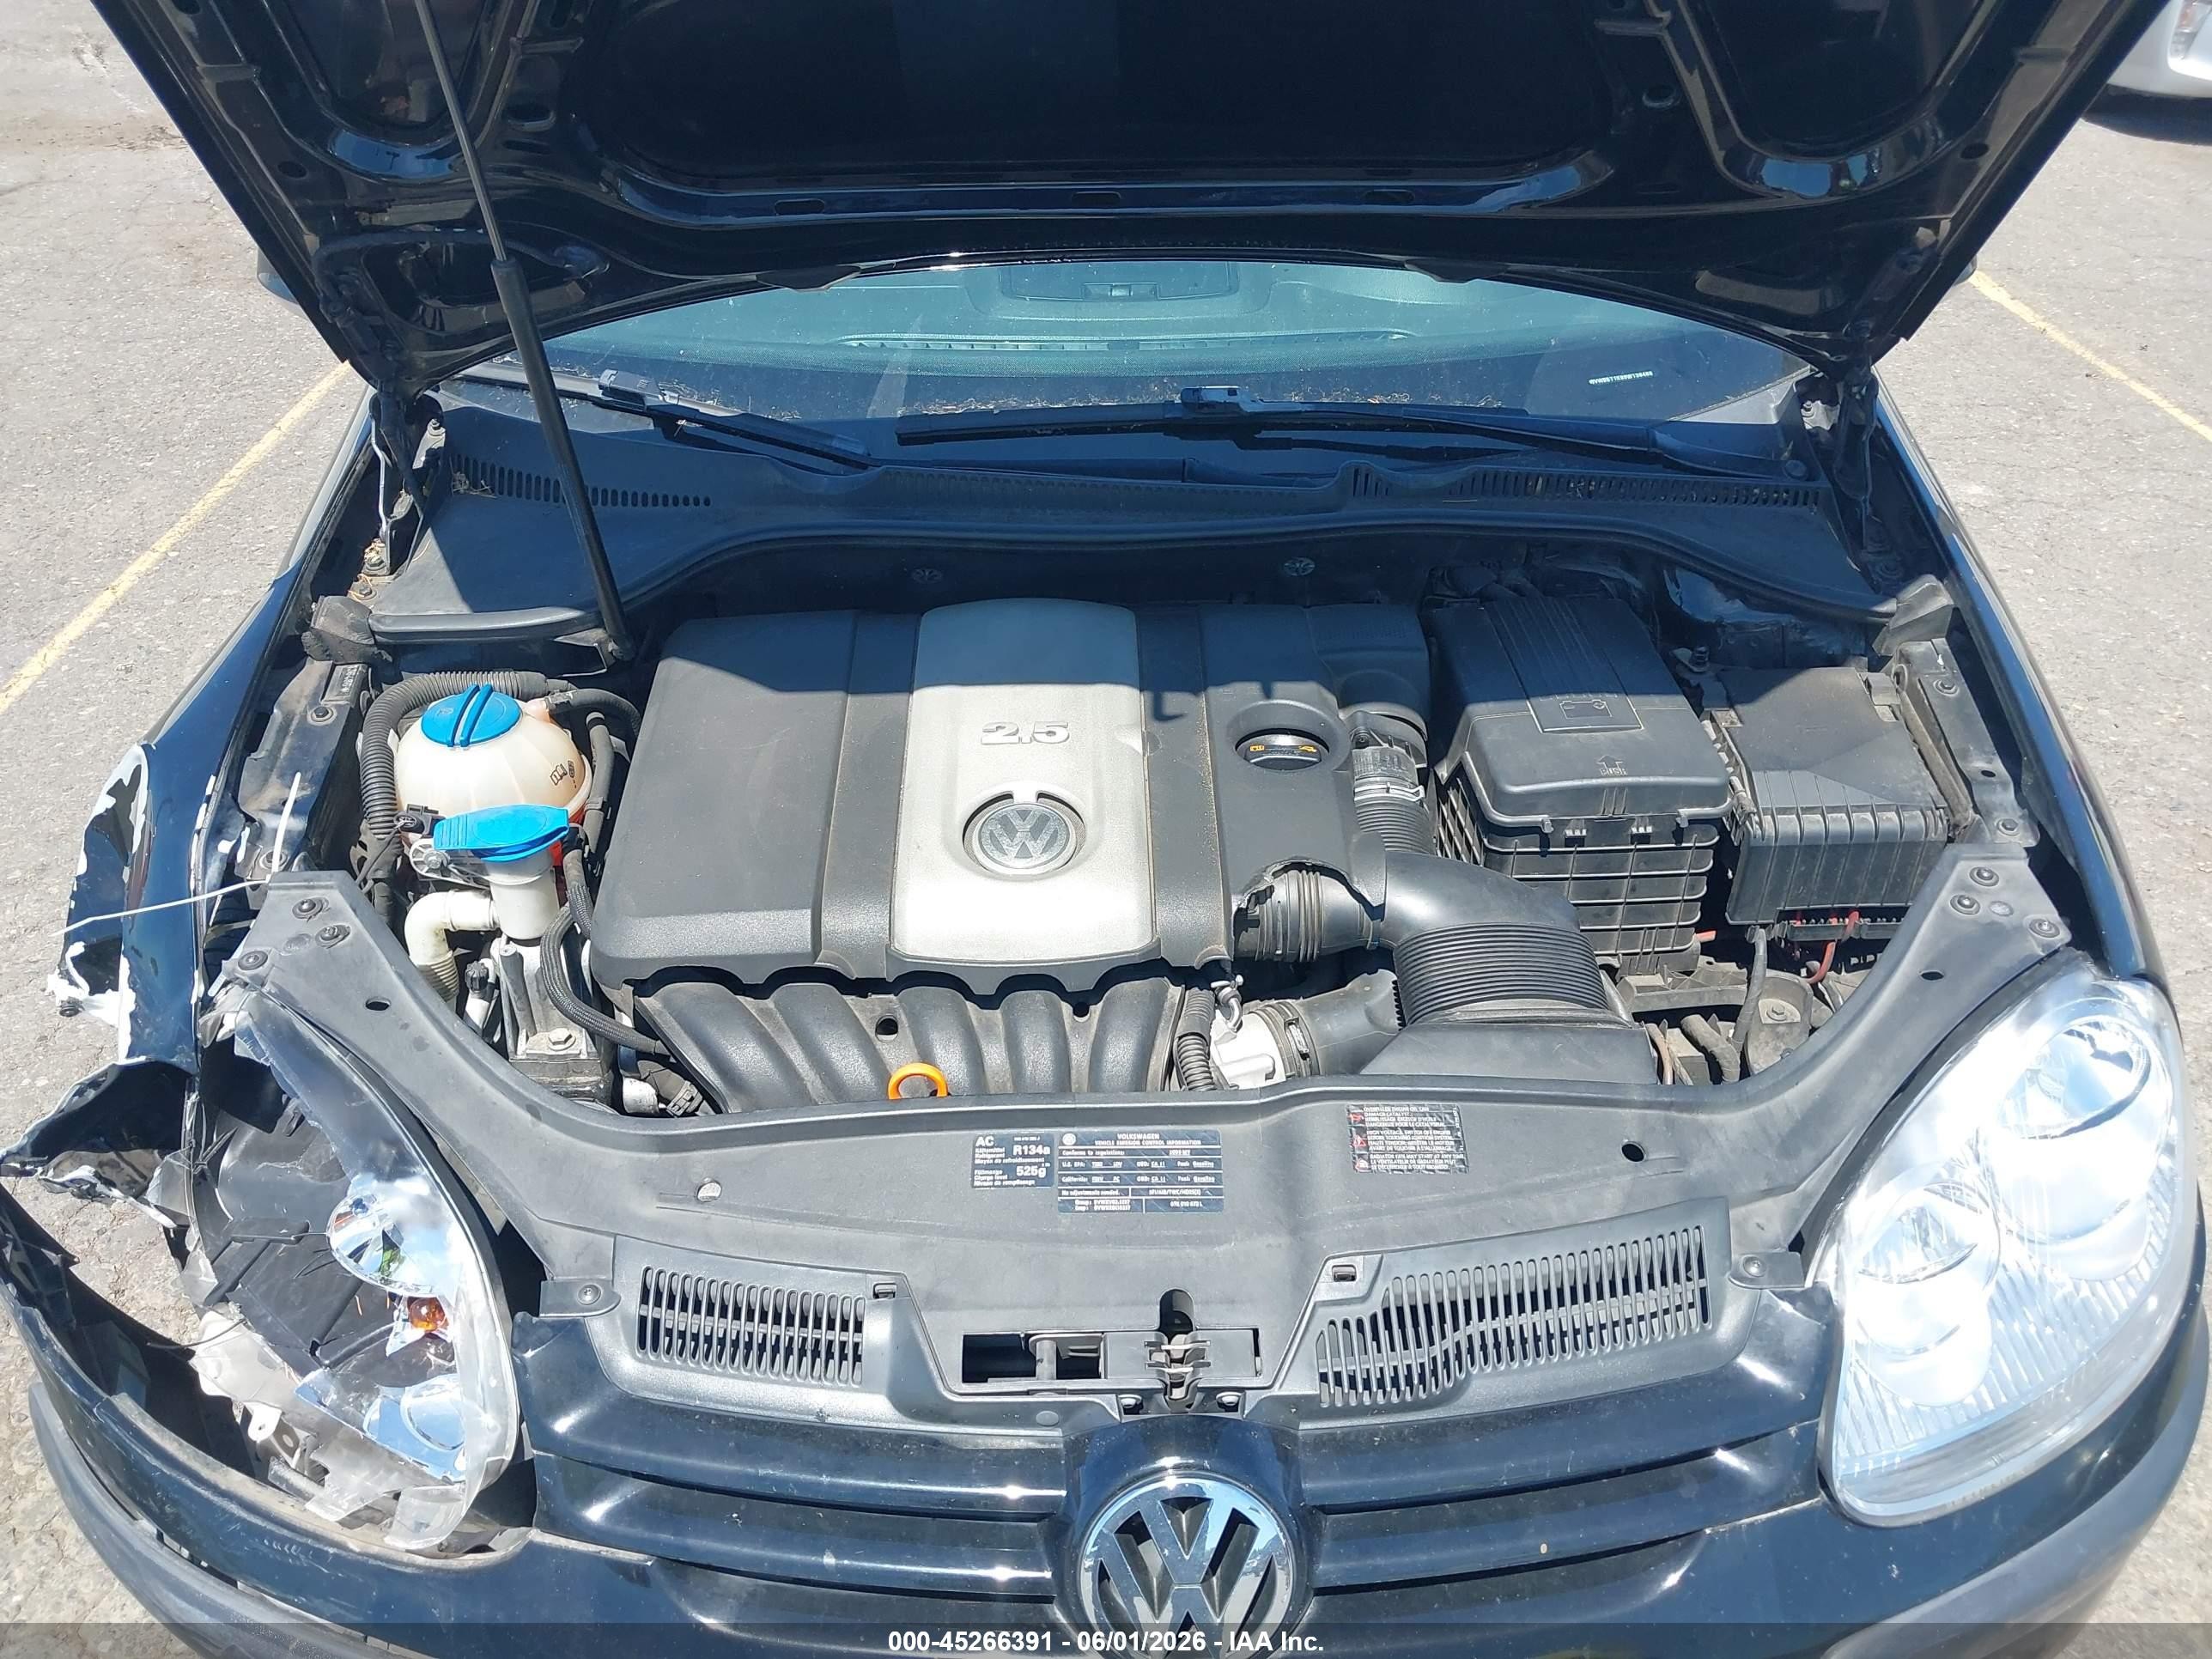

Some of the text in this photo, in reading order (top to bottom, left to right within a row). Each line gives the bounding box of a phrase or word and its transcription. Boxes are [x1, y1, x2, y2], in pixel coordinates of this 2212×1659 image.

[981, 721, 1071, 744] 2.5
[1601, 768, 1628, 776] PUSH
[975, 1135, 994, 1147] AC
[1013, 1145, 1051, 1155] R134a
[1017, 1165, 1047, 1178] 525g
